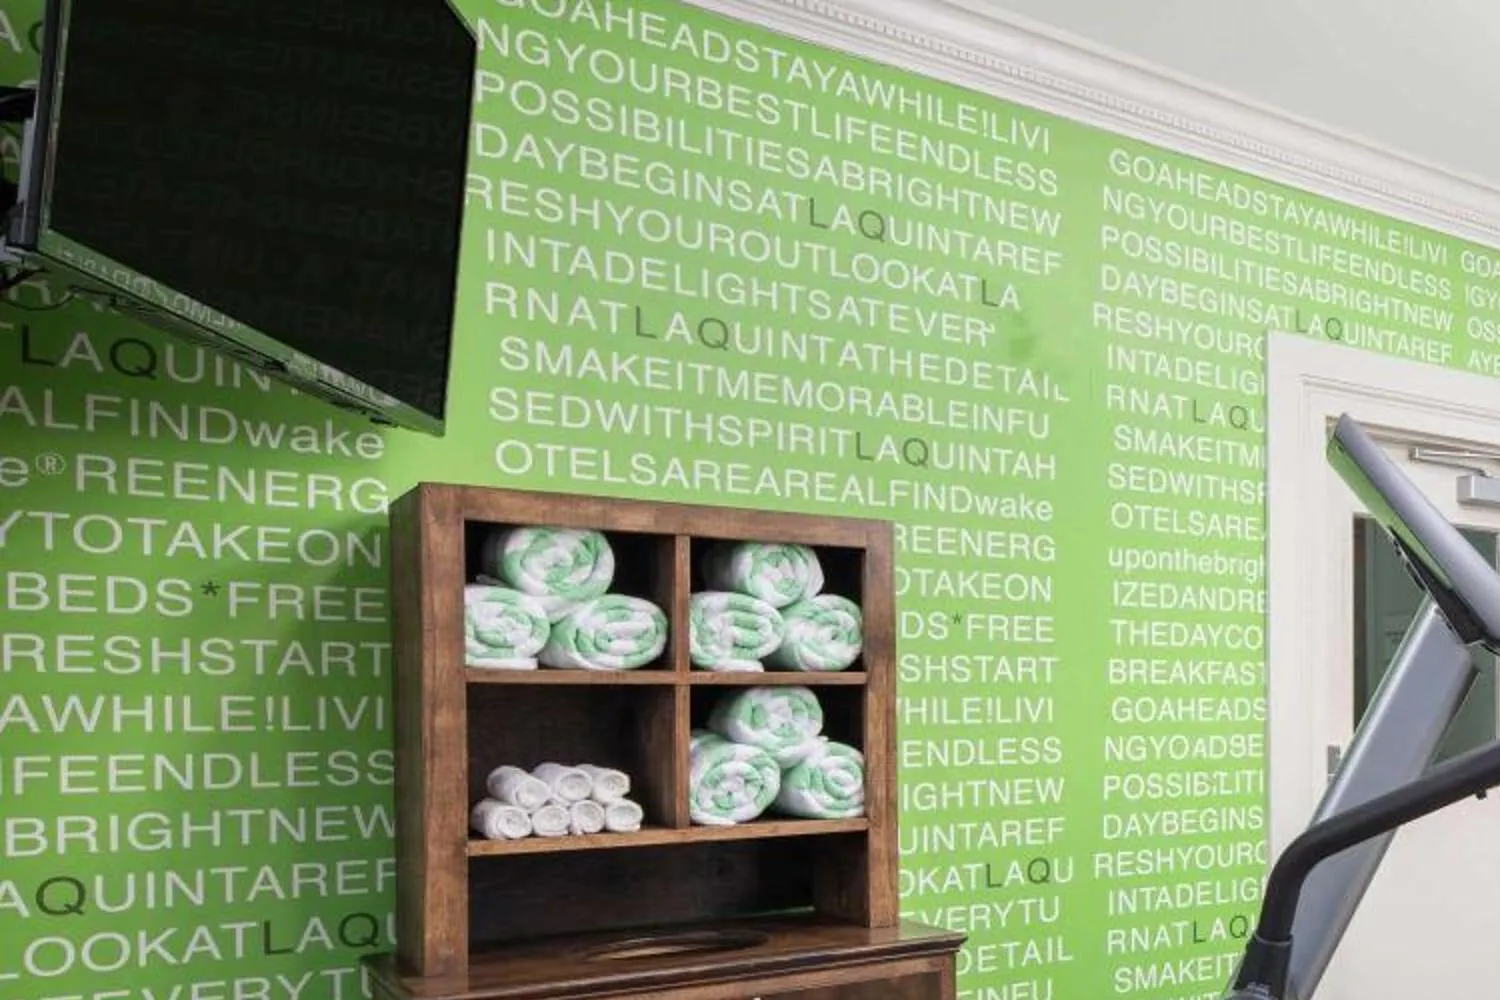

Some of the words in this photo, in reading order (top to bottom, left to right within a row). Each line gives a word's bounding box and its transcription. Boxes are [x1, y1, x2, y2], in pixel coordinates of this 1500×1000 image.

[499, 0, 1051, 154] OAHEADSTAYAWHILE!LIVI
[477, 18, 1059, 197] NGYOURBESTLIFEENDLESS
[475, 69, 1063, 238] POSSIBILITIESABRIGHTNEW
[475, 122, 1063, 276] DAYBEGINSATLAQUINTAREF
[0, 322, 298, 393] LAQUIN
[500, 336, 1050, 440] SMAKEITMEMORABLEINFU
[489, 387, 1056, 481] SEDWITHSPIRITLAQUINTAH
[1111, 501, 1267, 542] OTELSARE
[2, 634, 391, 677] RESHSTART
[900, 655, 1060, 684] SHSTART
[0, 694, 385, 734] AWHILE!LIVI
[902, 737, 1063, 768] ENDLESS
[903, 777, 1065, 812] IGHTNEW
[5, 805, 395, 857] BRIGHTNEW
[1103, 805, 1264, 839] DAYBEGINS
[898, 895, 1060, 933] VERYTU
